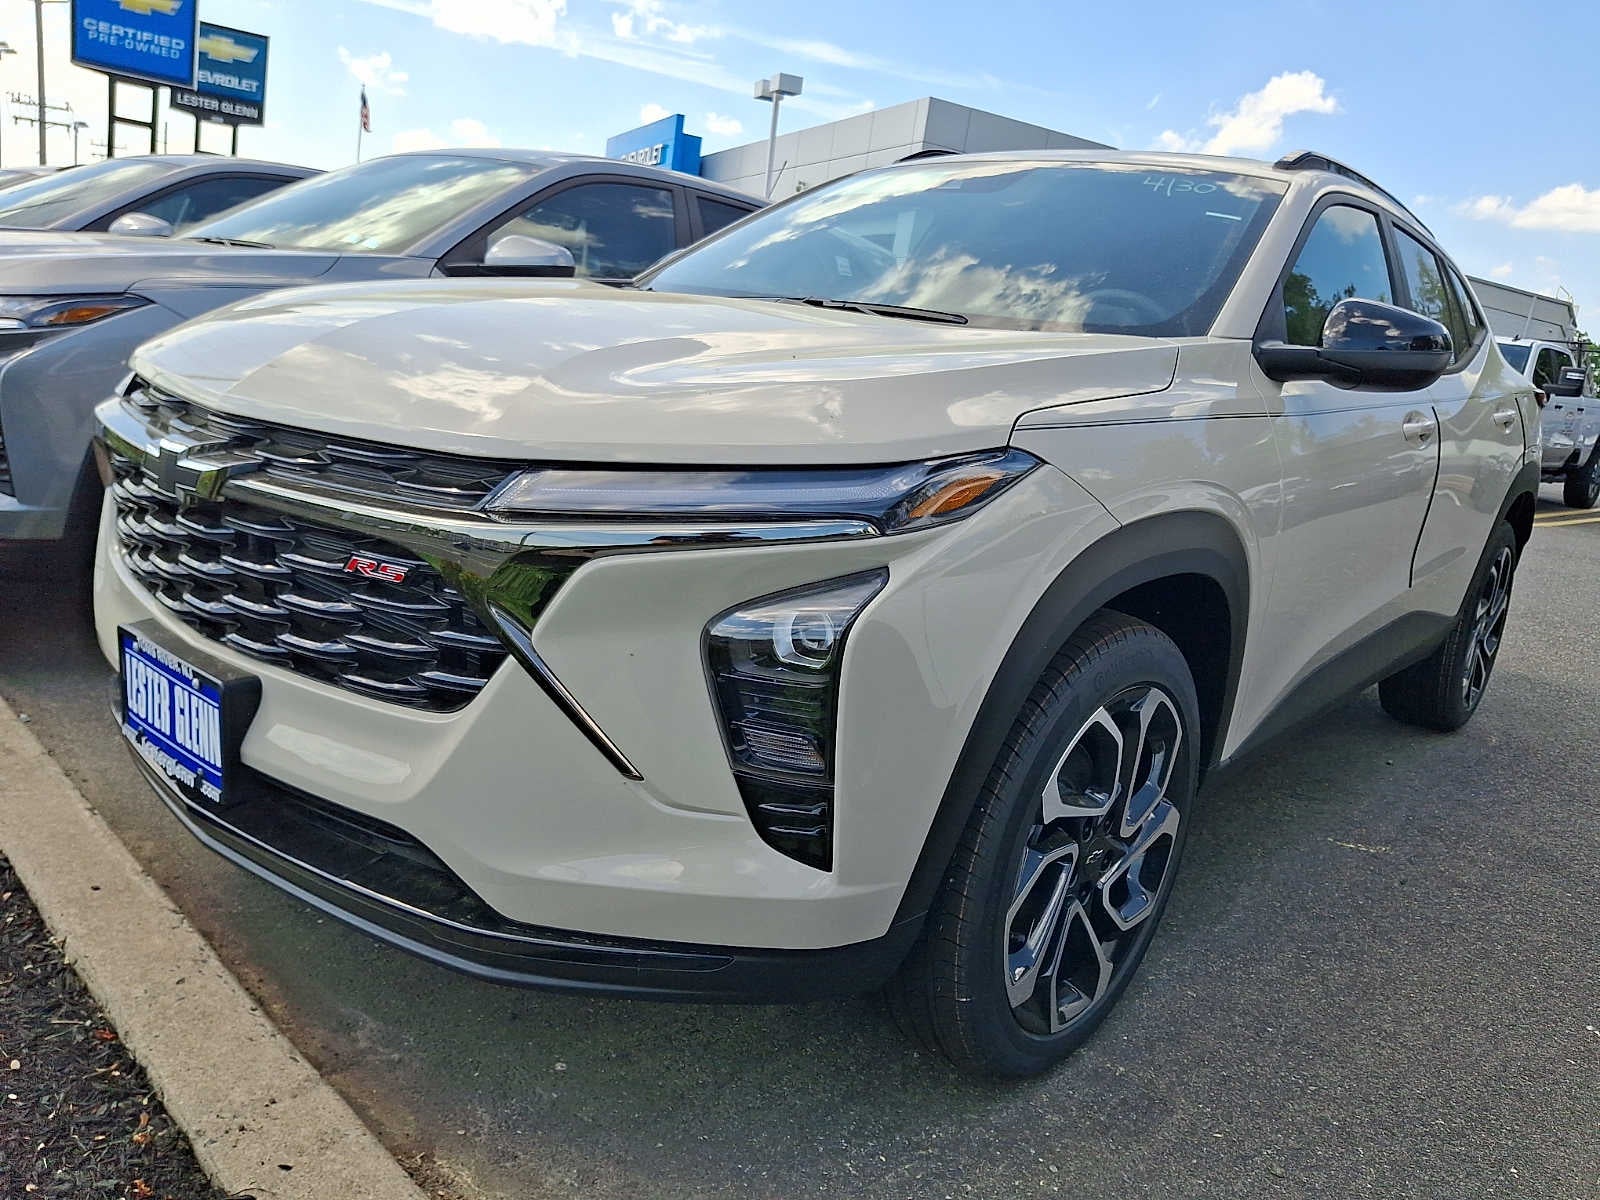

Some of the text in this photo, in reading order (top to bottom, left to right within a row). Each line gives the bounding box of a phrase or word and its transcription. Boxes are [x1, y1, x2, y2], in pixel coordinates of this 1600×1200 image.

[83, 17, 185, 50] CERTIFIED
[88, 30, 180, 59] PRE-OWNED
[198, 70, 259, 93] EVROLET
[177, 93, 219, 111] LESTER
[220, 101, 258, 119] GLENN
[1143, 177, 1217, 197] 4/30
[343, 556, 409, 583] RS
[125, 652, 222, 768] LESTER GLENN
